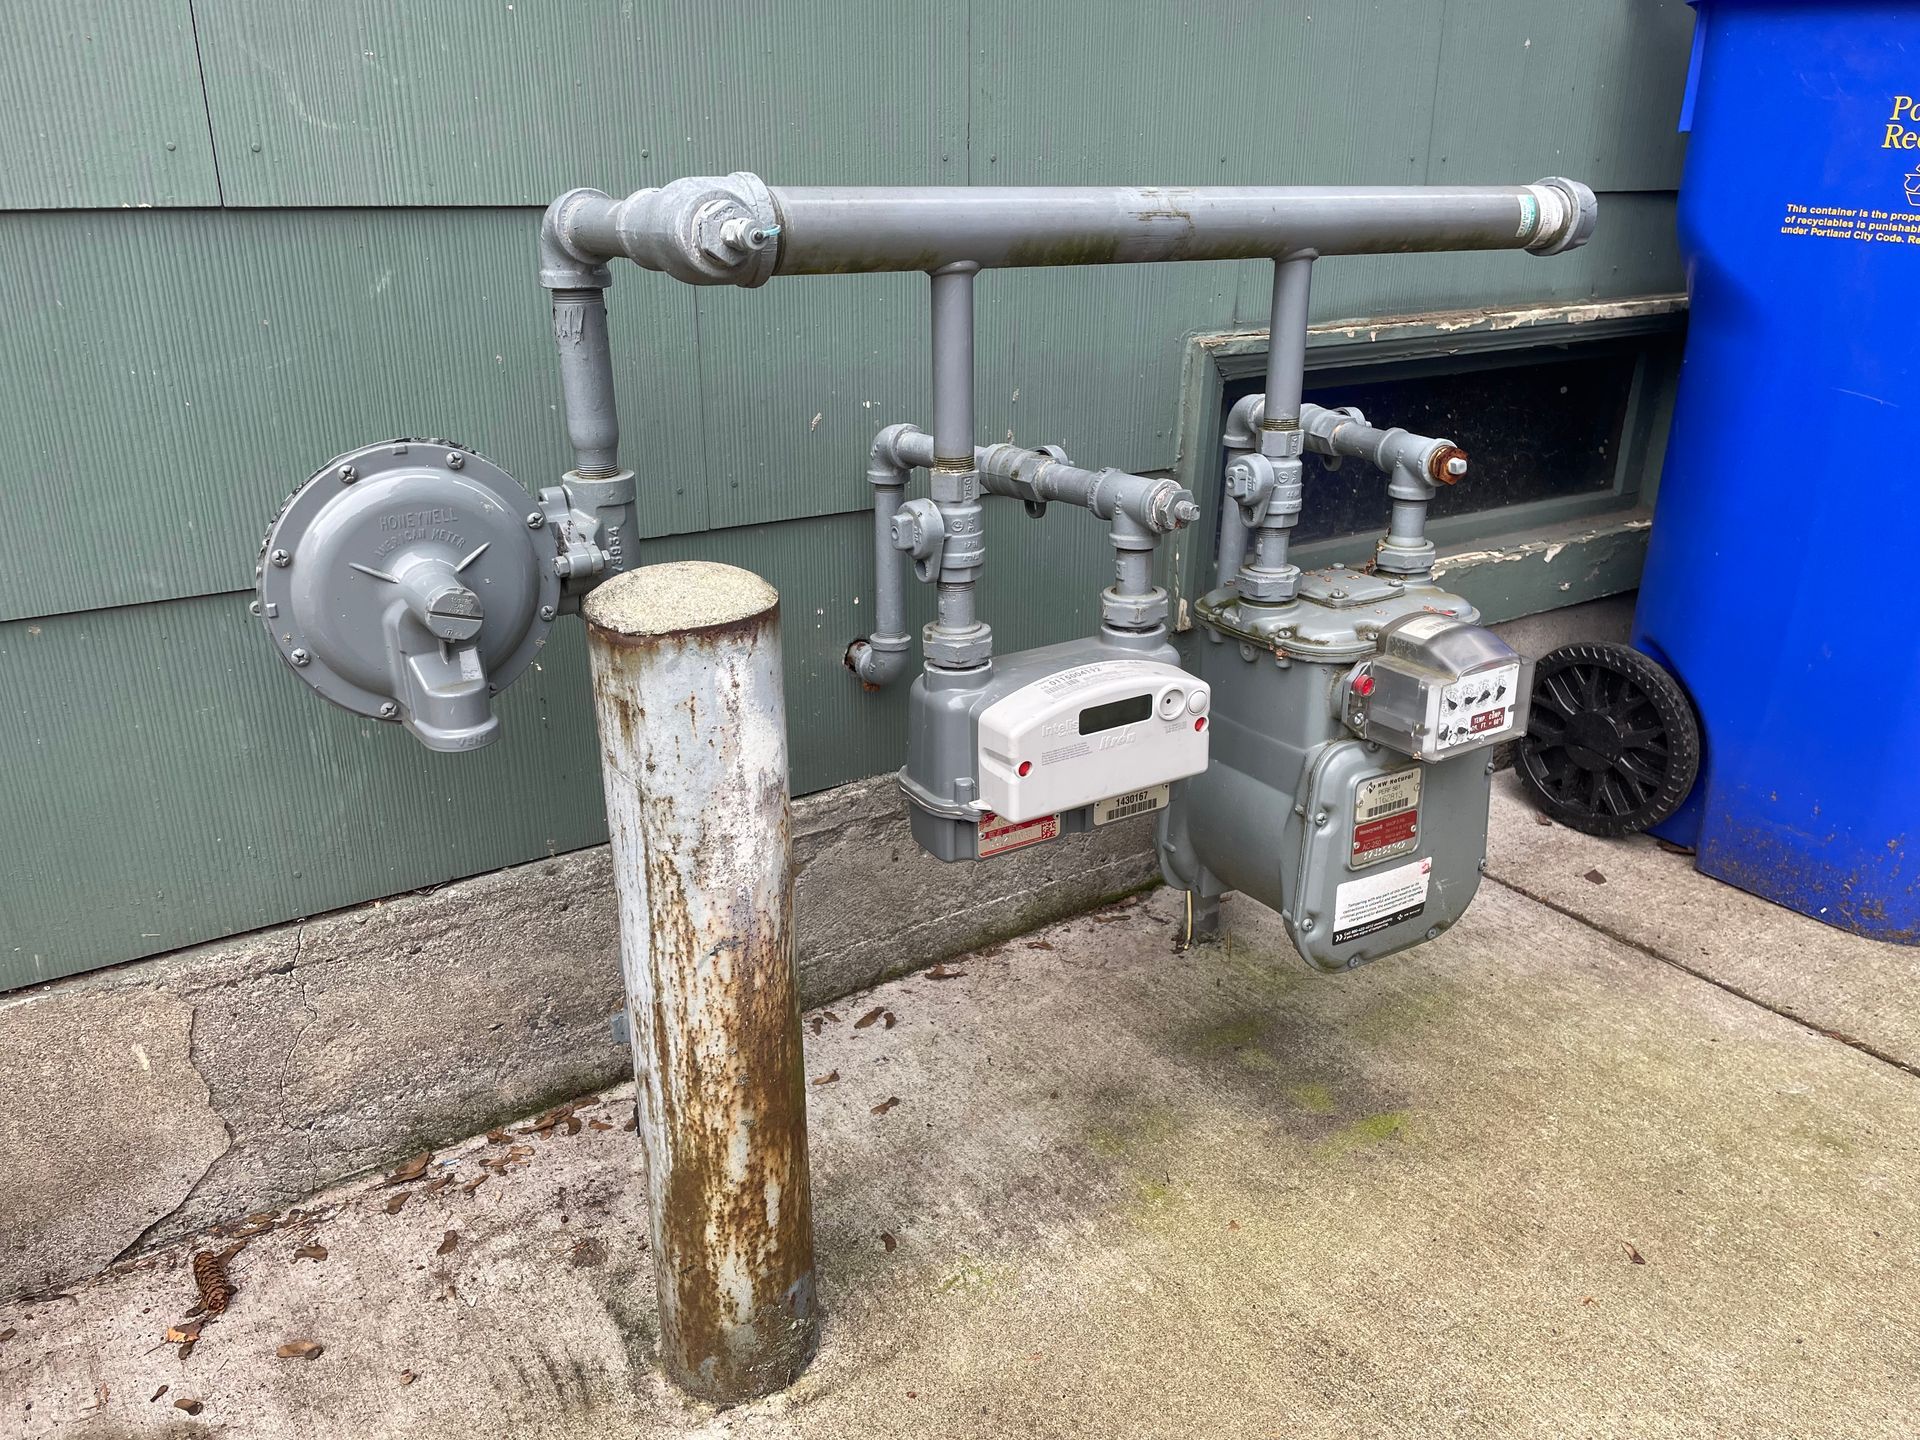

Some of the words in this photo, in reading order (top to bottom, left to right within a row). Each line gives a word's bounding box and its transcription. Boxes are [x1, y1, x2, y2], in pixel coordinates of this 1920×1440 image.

[1881, 123, 1920, 150] Re
[1787, 203, 1807, 213] This
[1810, 206, 1857, 217] container
[1859, 208, 1868, 218] is
[1871, 210, 1887, 219] the
[1785, 215, 1795, 224] of
[1797, 217, 1853, 228] recyclables
[1856, 220, 1866, 229] is
[1781, 225, 1808, 235] under
[1810, 227, 1851, 239] Portland
[1853, 230, 1873, 242] City
[1876, 232, 1905, 243] Code.
[380, 507, 460, 531] HONEYWELL
[431, 528, 466, 549] METER
[1389, 772, 1414, 785] Natural
[1115, 790, 1149, 807] 1430167
[1375, 790, 1403, 805] 1162813
